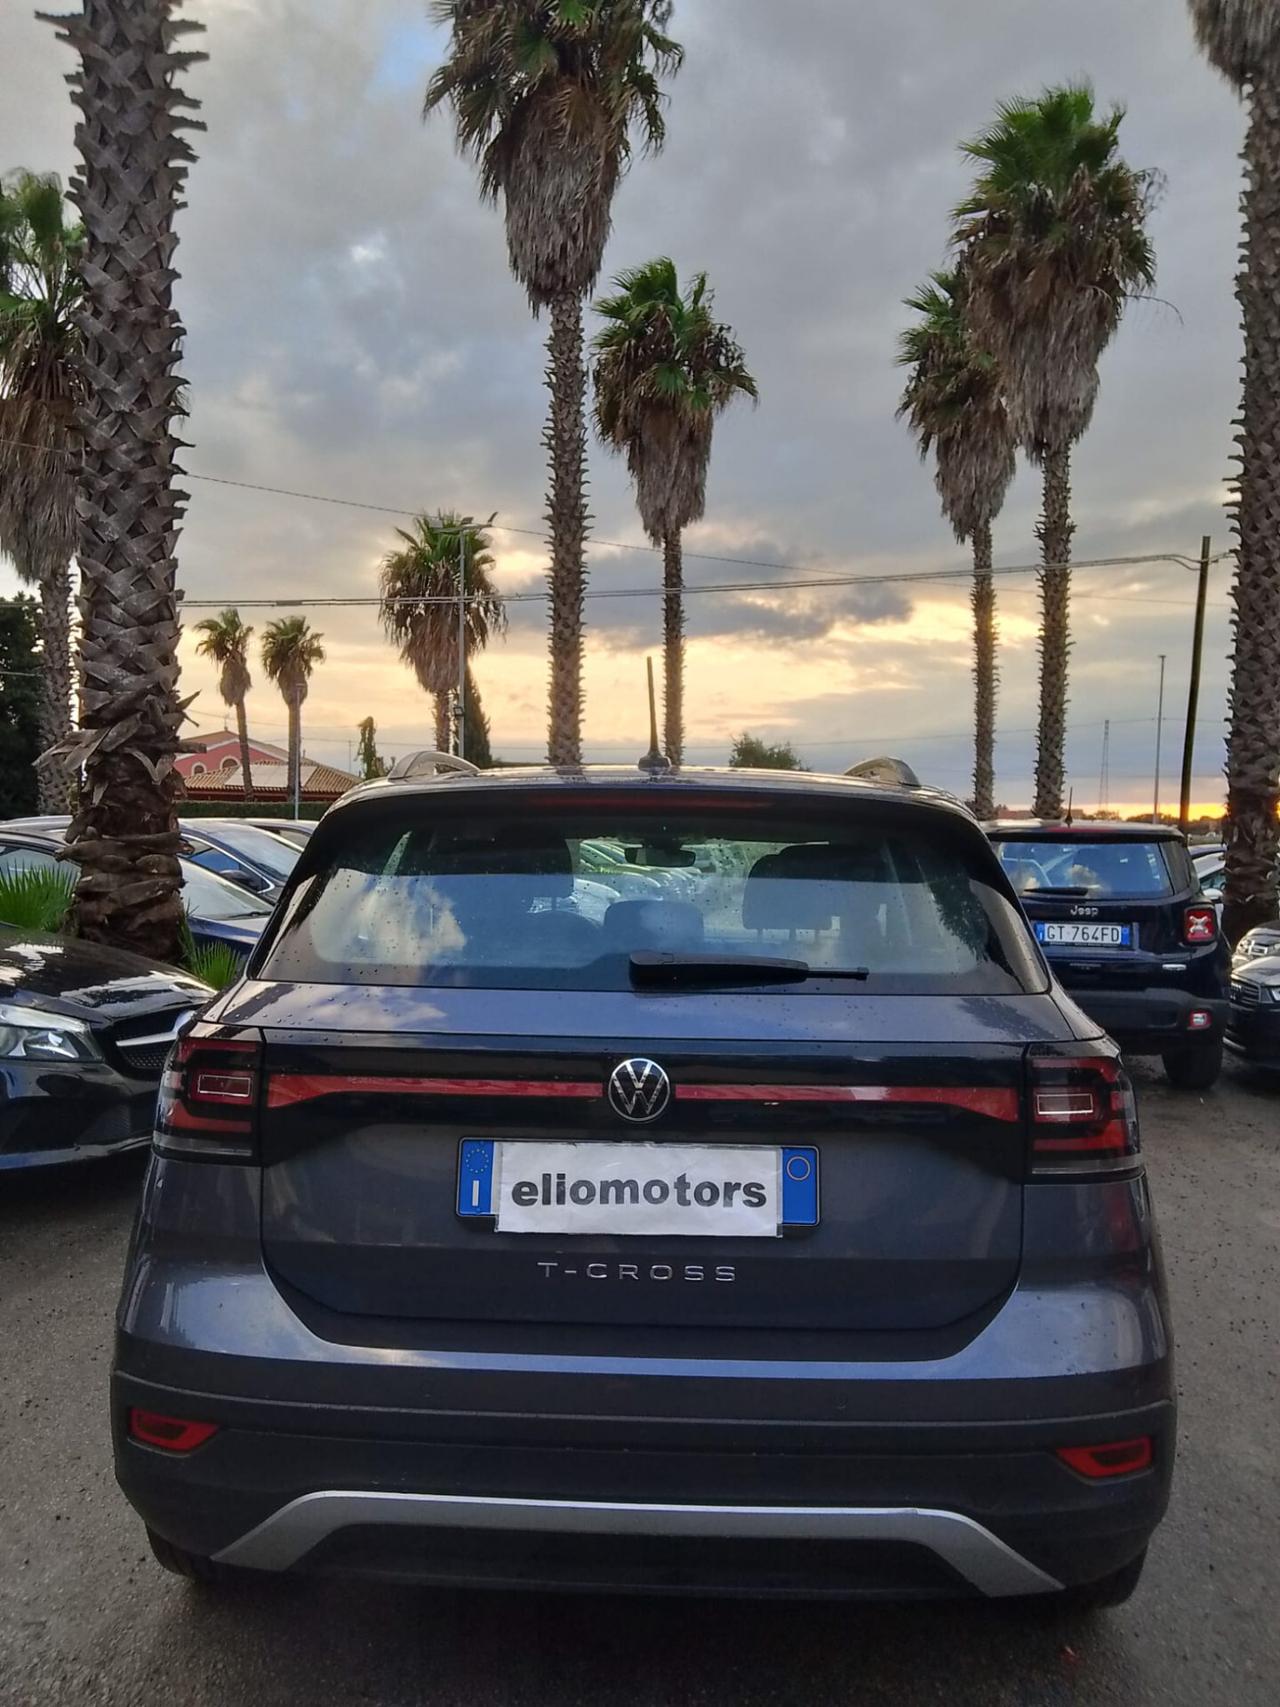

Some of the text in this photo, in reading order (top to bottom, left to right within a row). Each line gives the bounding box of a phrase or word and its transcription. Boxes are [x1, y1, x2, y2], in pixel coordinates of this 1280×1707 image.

[1070, 905, 1099, 917] Jeep
[1047, 925, 1065, 940] GT
[511, 1173, 767, 1208] eliomotors
[537, 1262, 736, 1282] T-CROSS
